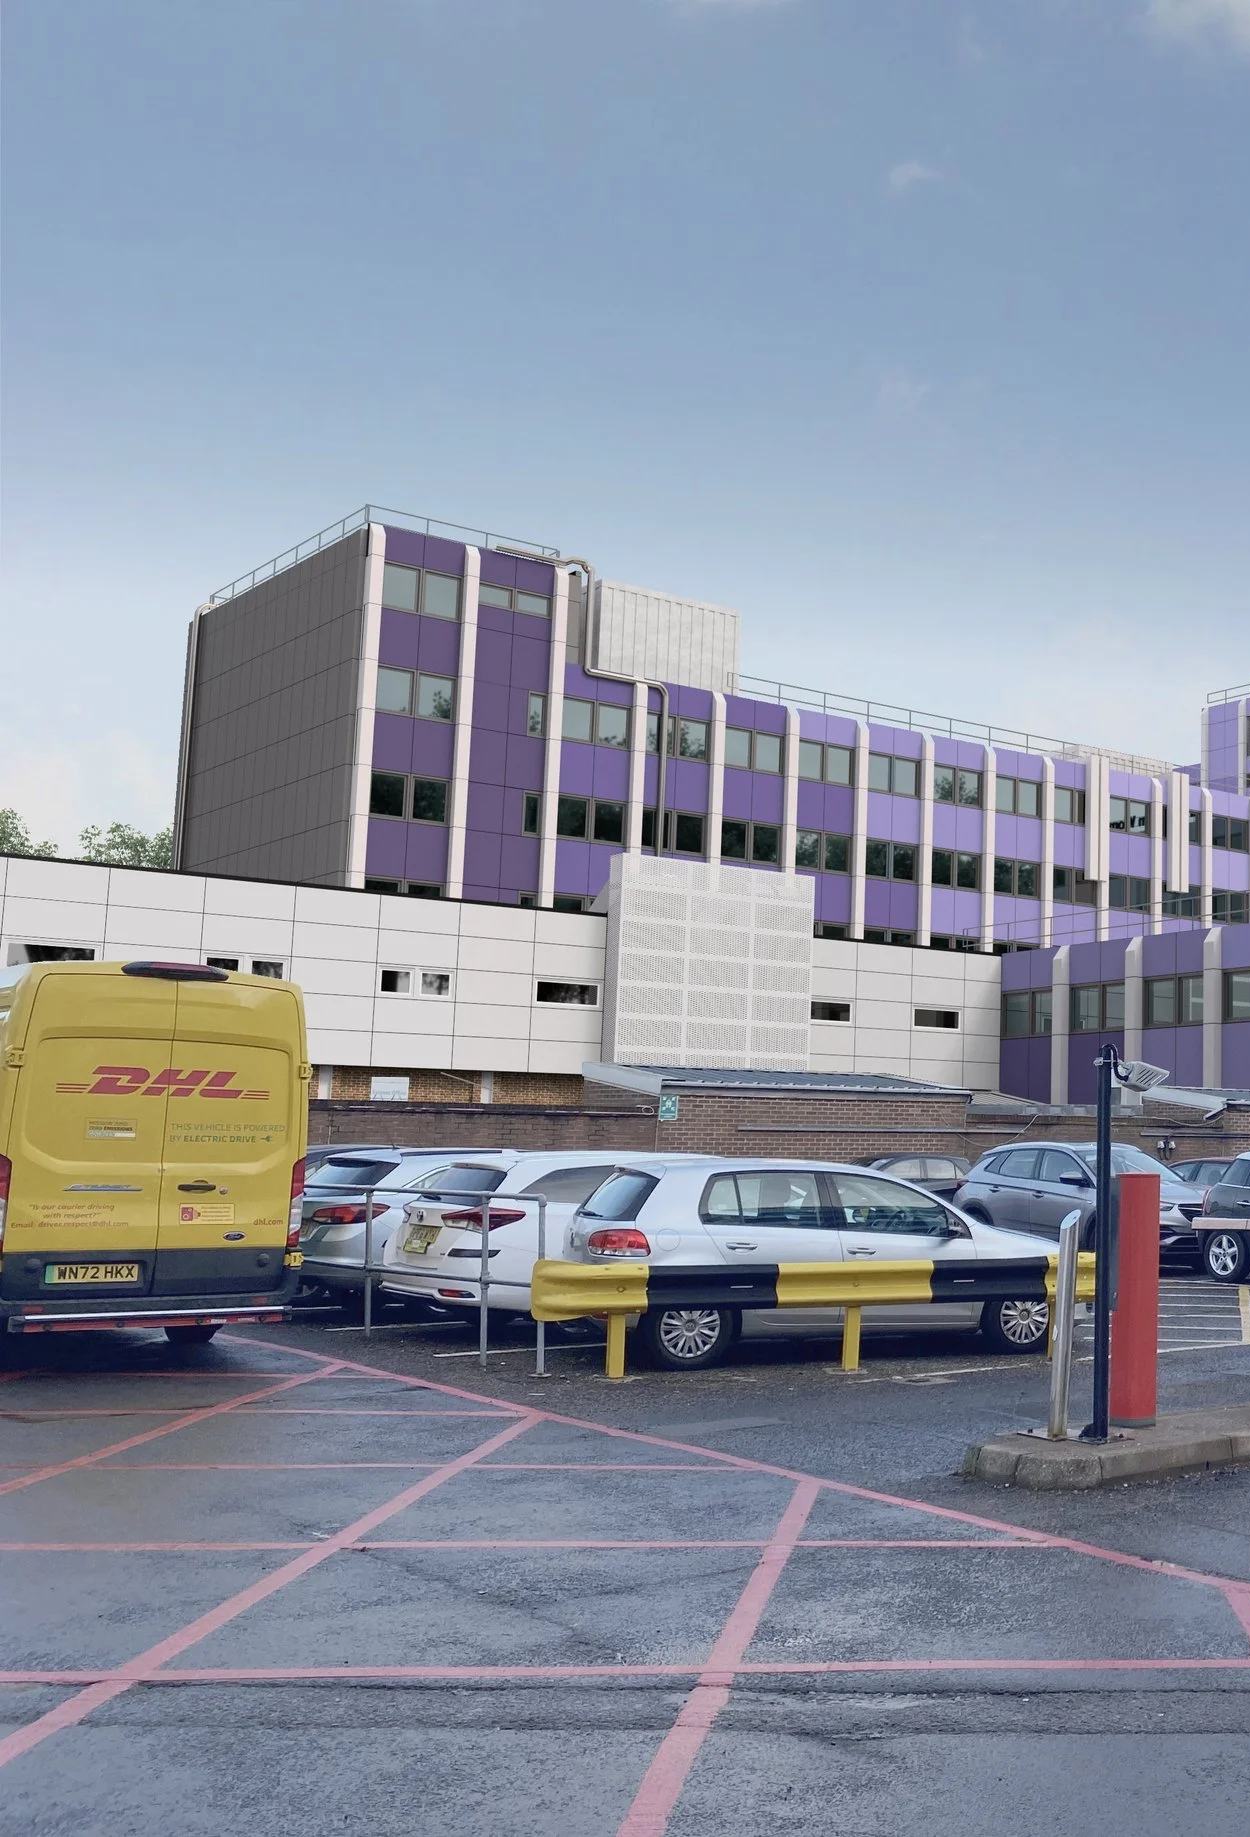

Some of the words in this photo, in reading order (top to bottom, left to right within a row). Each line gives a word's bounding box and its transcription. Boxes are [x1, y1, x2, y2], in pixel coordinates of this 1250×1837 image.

[87, 1065, 245, 1099] DHL
[171, 1123, 192, 1131] THIS
[193, 1123, 231, 1132] VEHICLE
[233, 1123, 241, 1132] IS
[243, 1124, 286, 1132] POWERED
[169, 1135, 181, 1143] BY
[183, 1135, 228, 1143] ELECTRIC
[229, 1135, 256, 1143] DRIVE
[87, 1203, 115, 1211] driving
[57, 1266, 100, 1280] WN72
[104, 1265, 135, 1279] HKX
